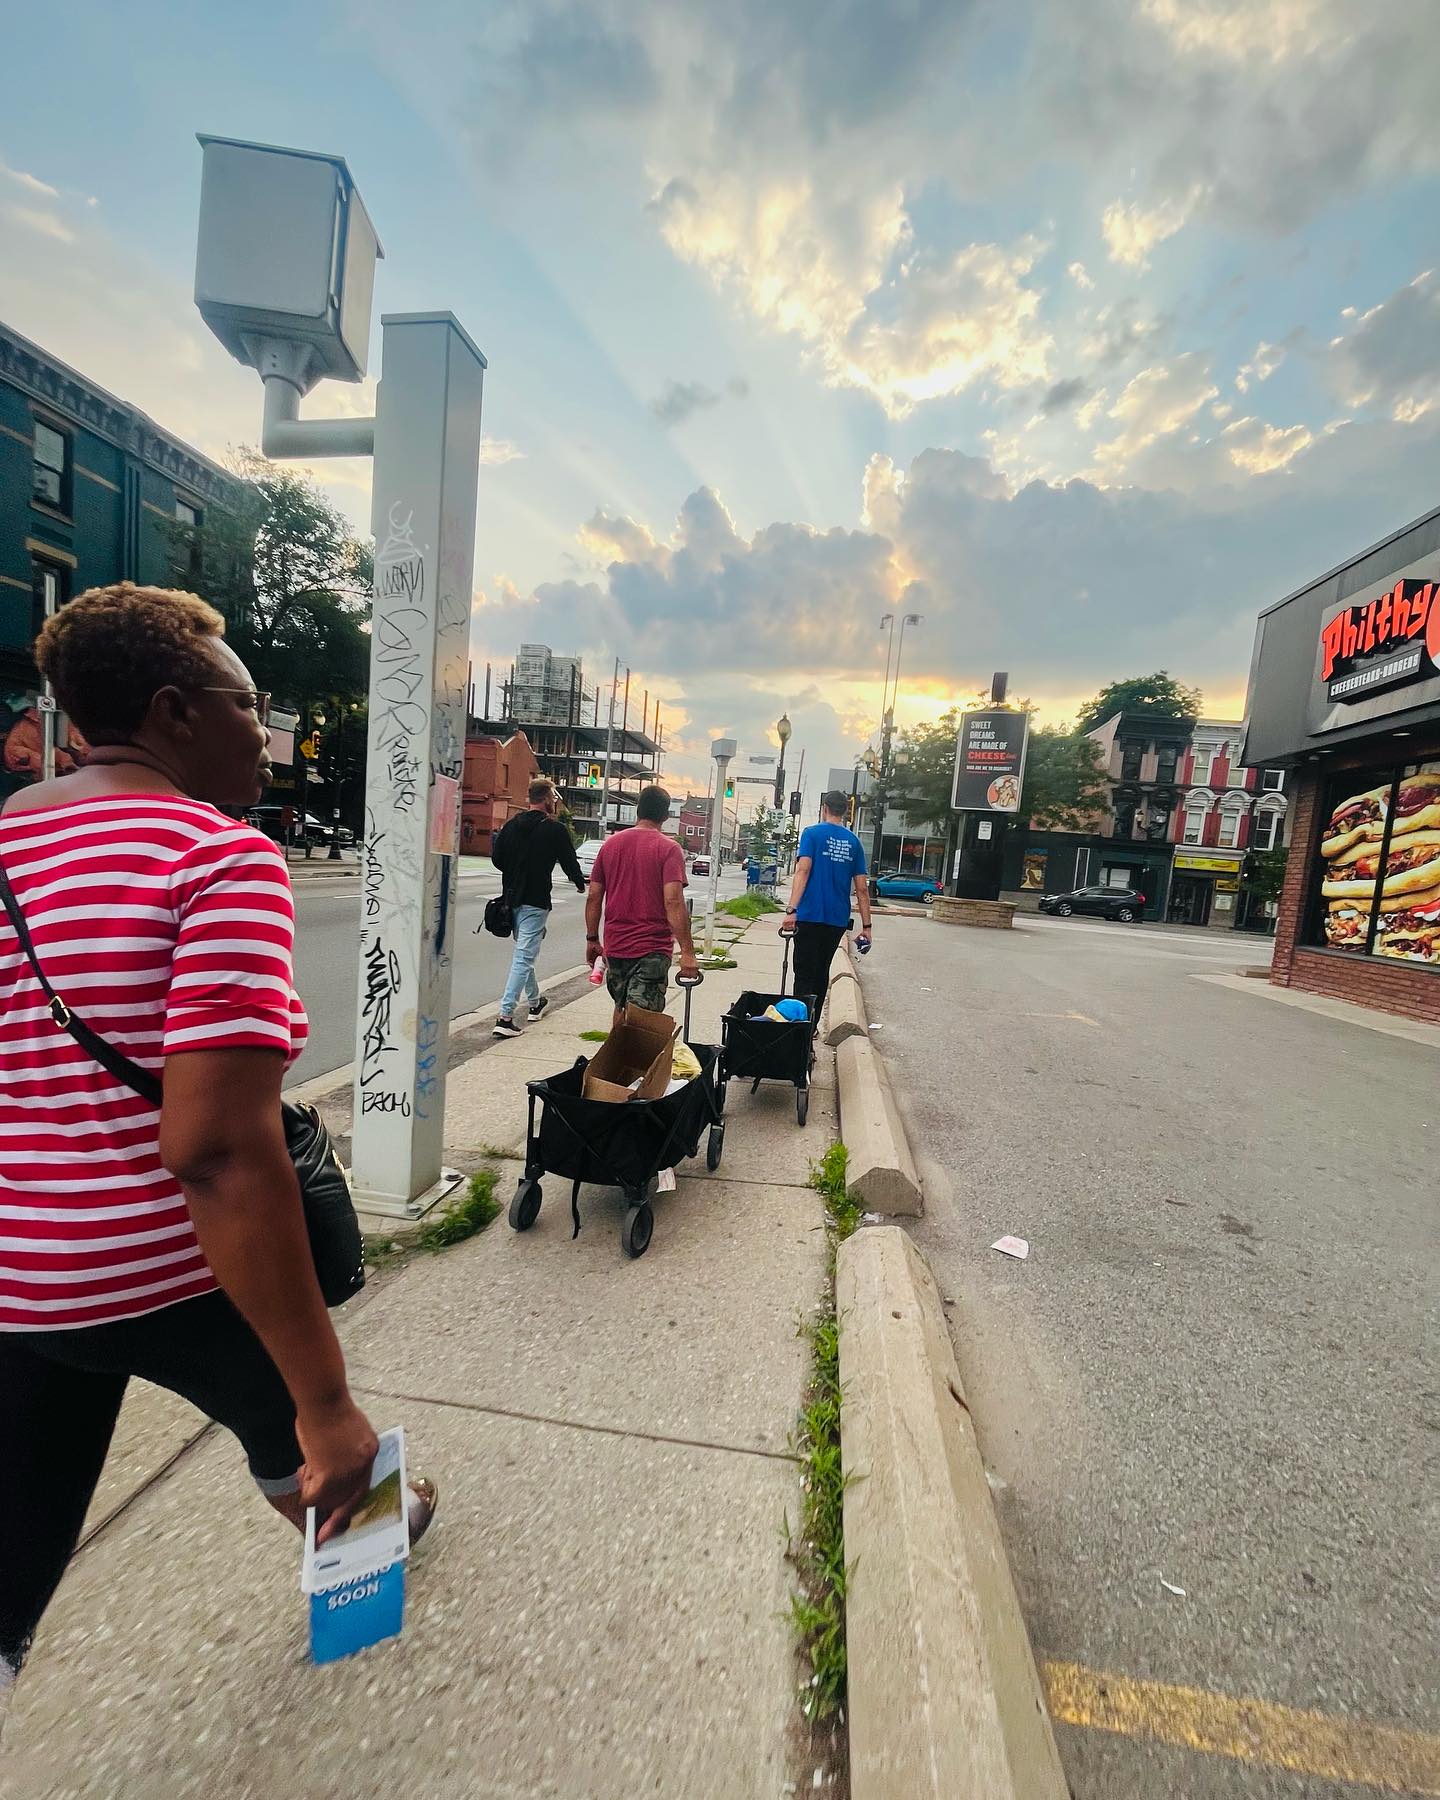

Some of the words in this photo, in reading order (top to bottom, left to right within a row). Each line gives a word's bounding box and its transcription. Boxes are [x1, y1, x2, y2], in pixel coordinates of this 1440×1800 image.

[1321, 579, 1433, 681] Philthy
[971, 721, 991, 729] SWEET
[970, 731, 995, 739] DREAMS
[968, 741, 981, 749] ARE
[981, 741, 999, 750] MADE
[999, 742, 1008, 750] OF
[327, 1579, 380, 1611] SOON
